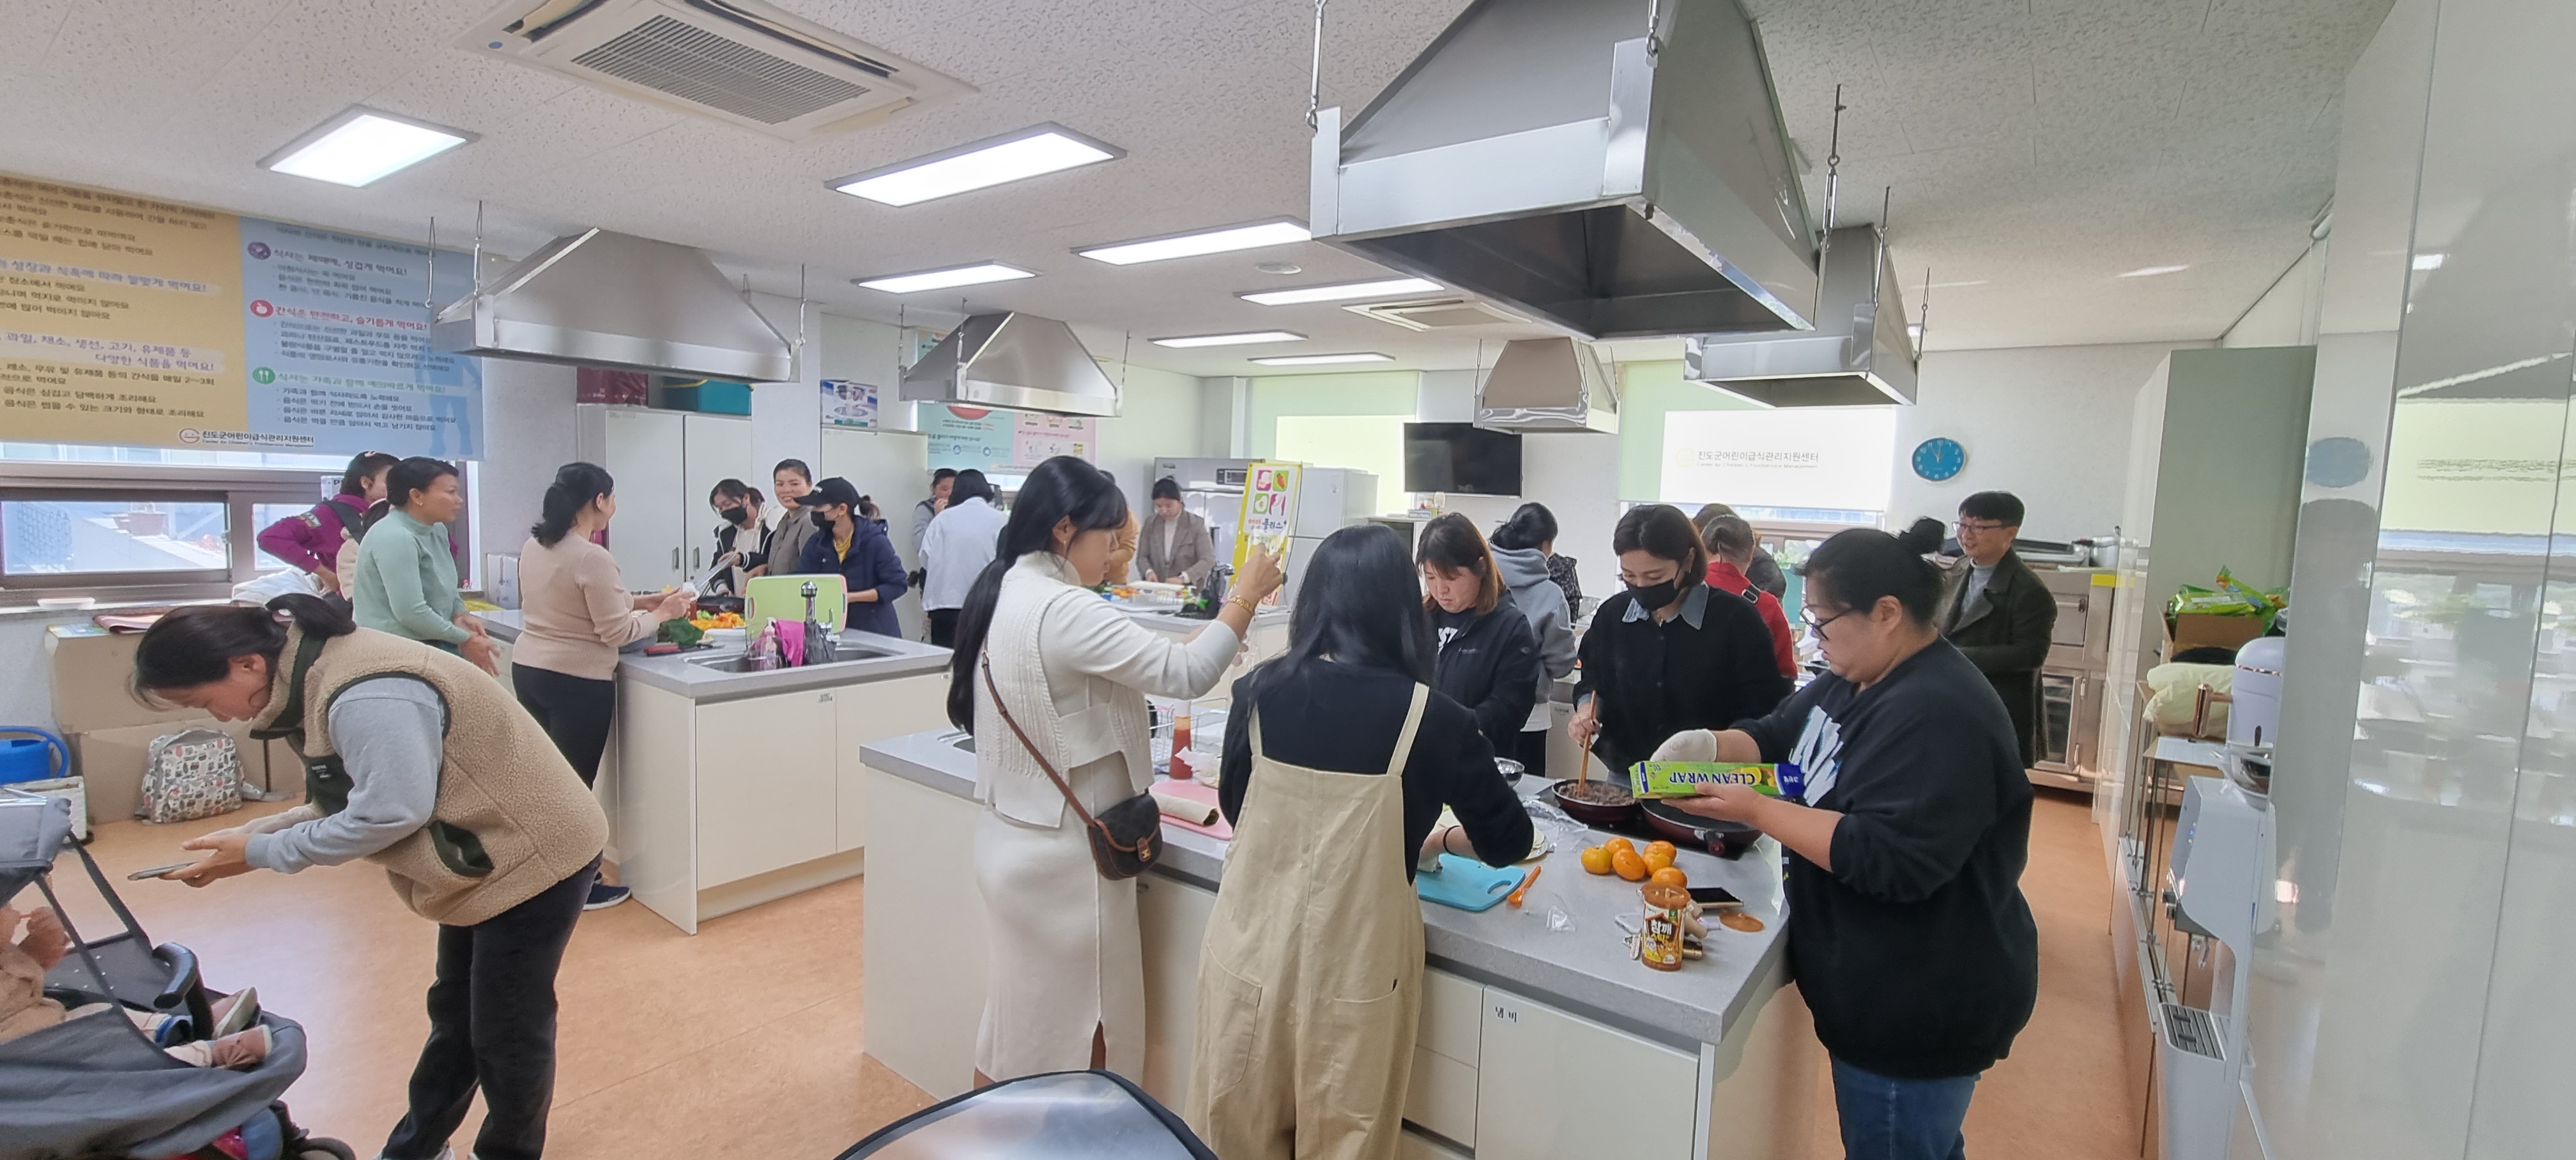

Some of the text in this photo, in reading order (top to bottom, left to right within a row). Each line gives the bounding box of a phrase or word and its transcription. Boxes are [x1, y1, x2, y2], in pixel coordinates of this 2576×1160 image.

[344, 259, 374, 271] 싱겁게
[203, 431, 314, 443] 진도군어린이급식관리지원센터
[1698, 450, 1819, 462] 진도군어린이급식관리지원센터
[1668, 772, 1756, 785] CLEAN WRAP
[1652, 919, 1672, 935] 참깨
